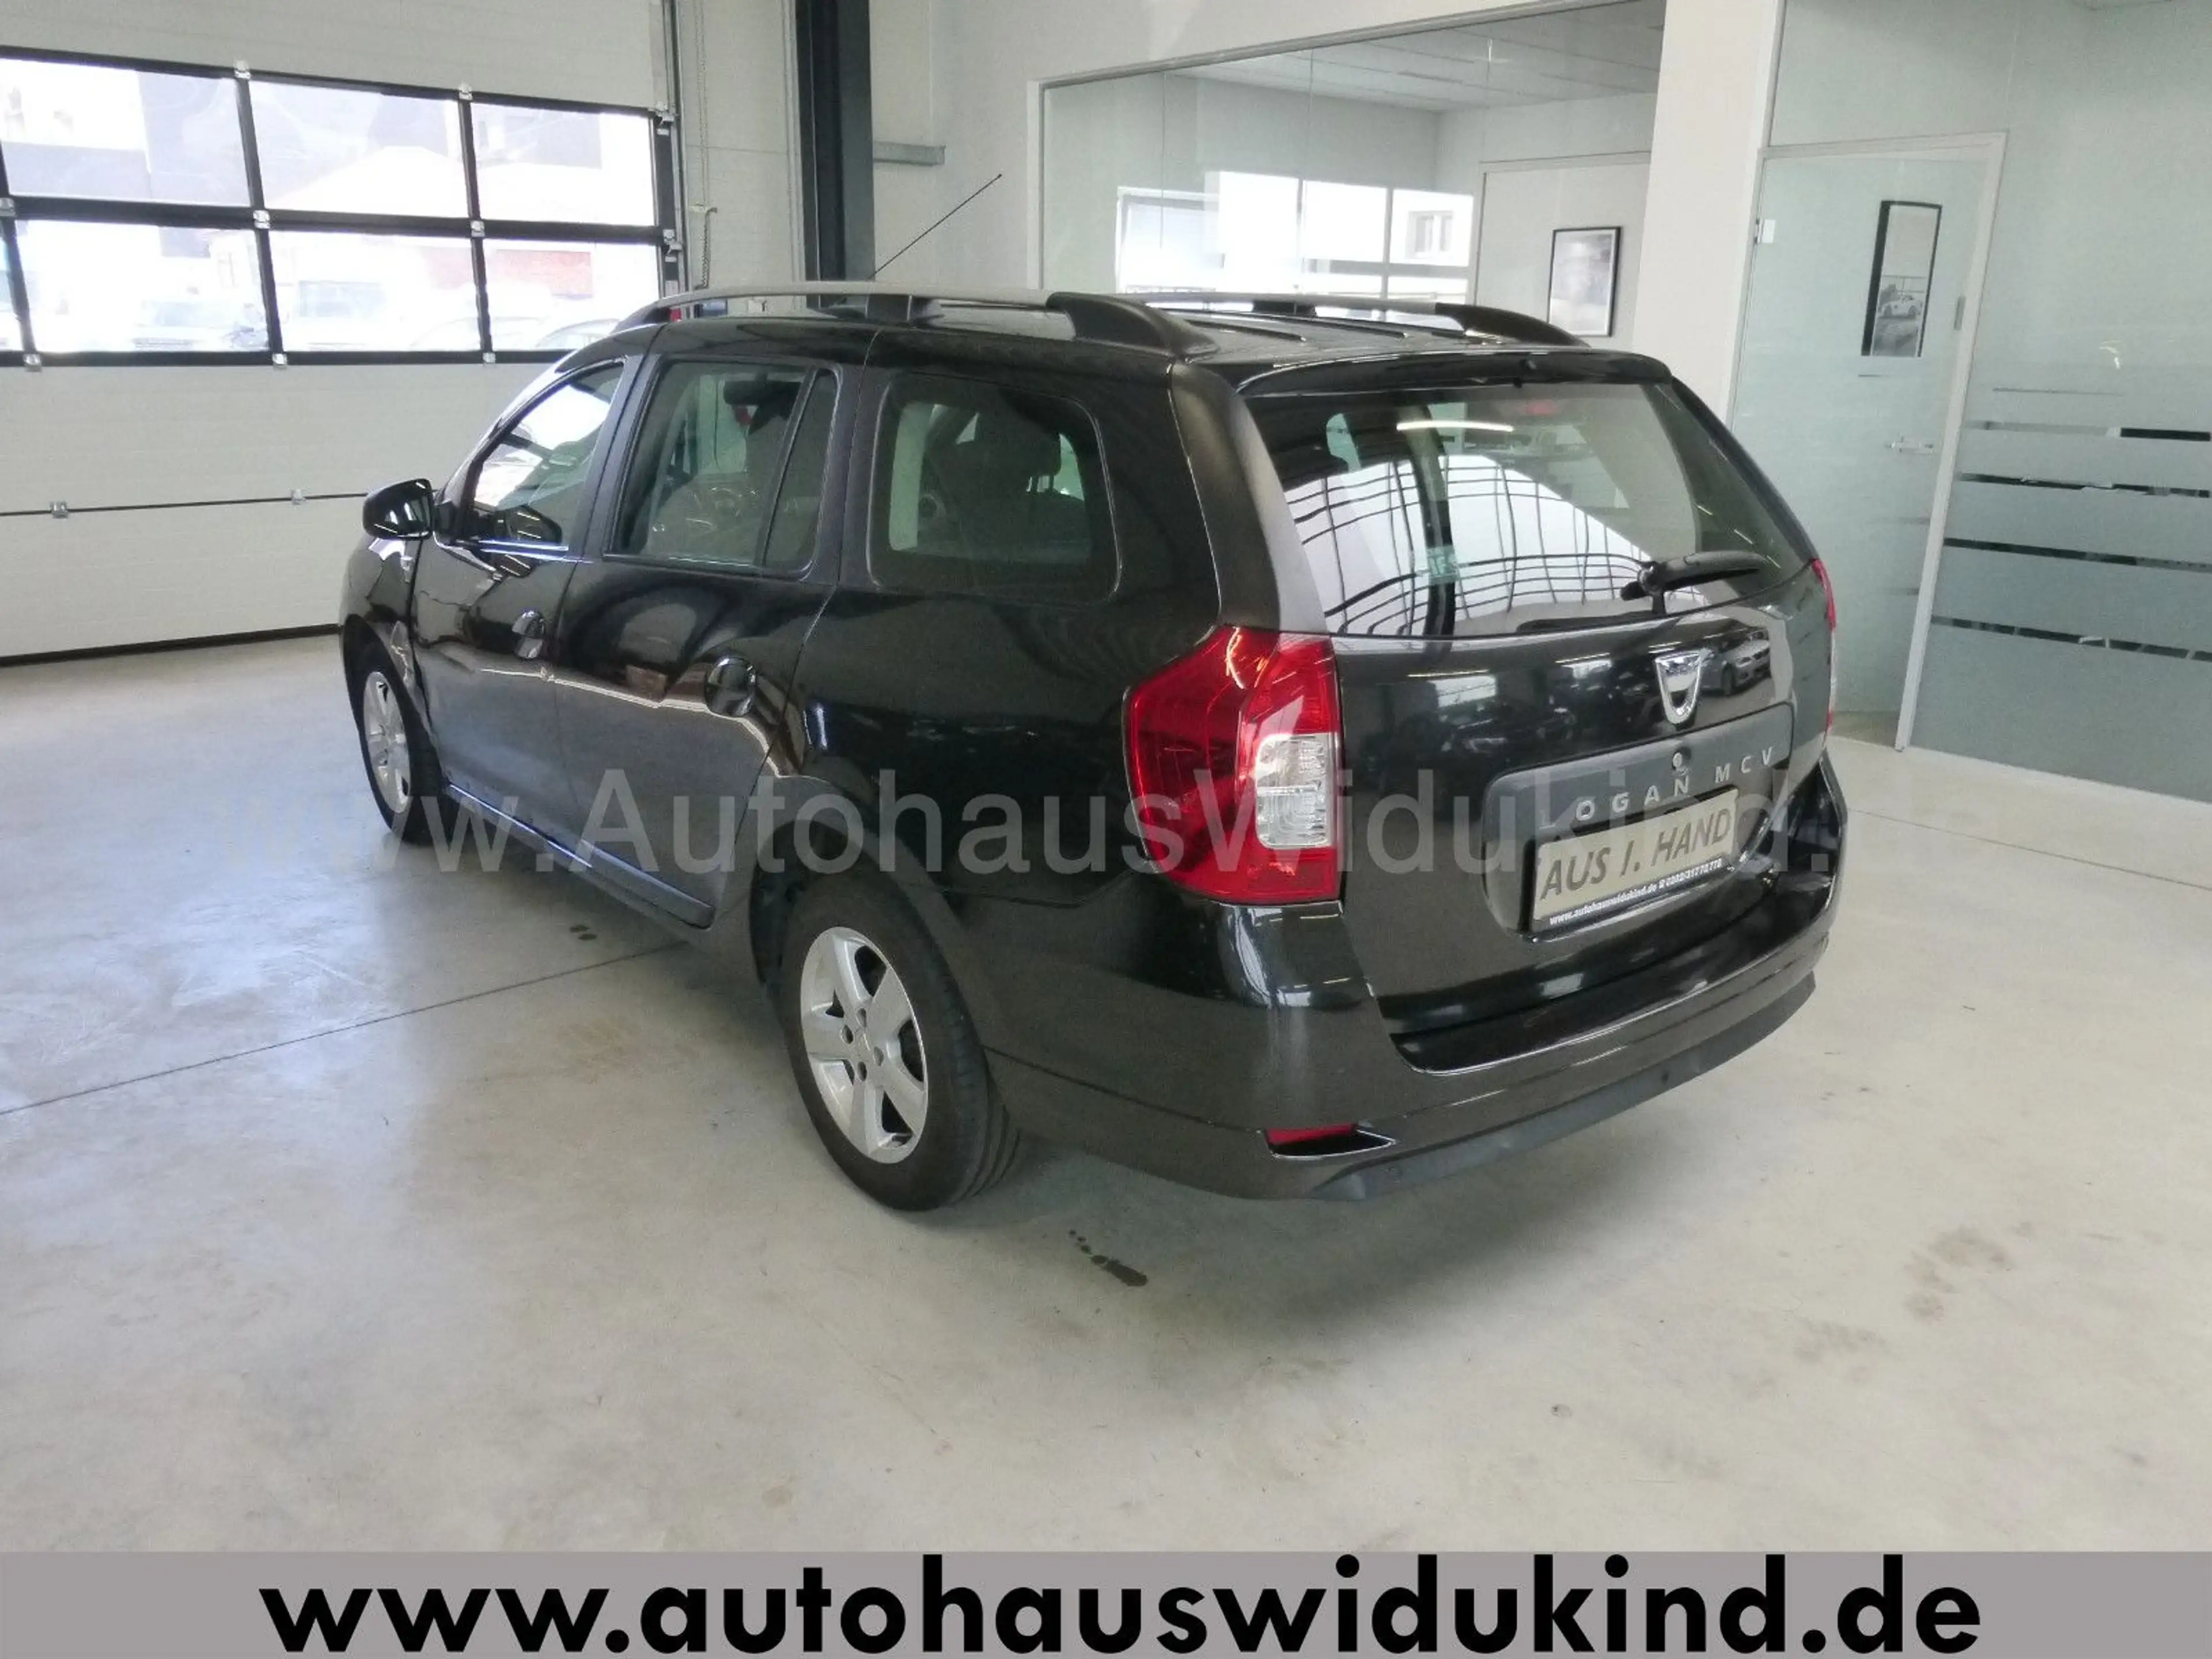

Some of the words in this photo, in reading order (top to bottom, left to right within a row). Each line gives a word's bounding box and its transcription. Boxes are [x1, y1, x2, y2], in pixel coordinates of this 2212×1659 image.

[1539, 775, 1690, 830] LOGAN
[1715, 747, 1773, 783] MCV
[1540, 846, 1611, 900] AUS
[1651, 808, 1732, 867] HAND
